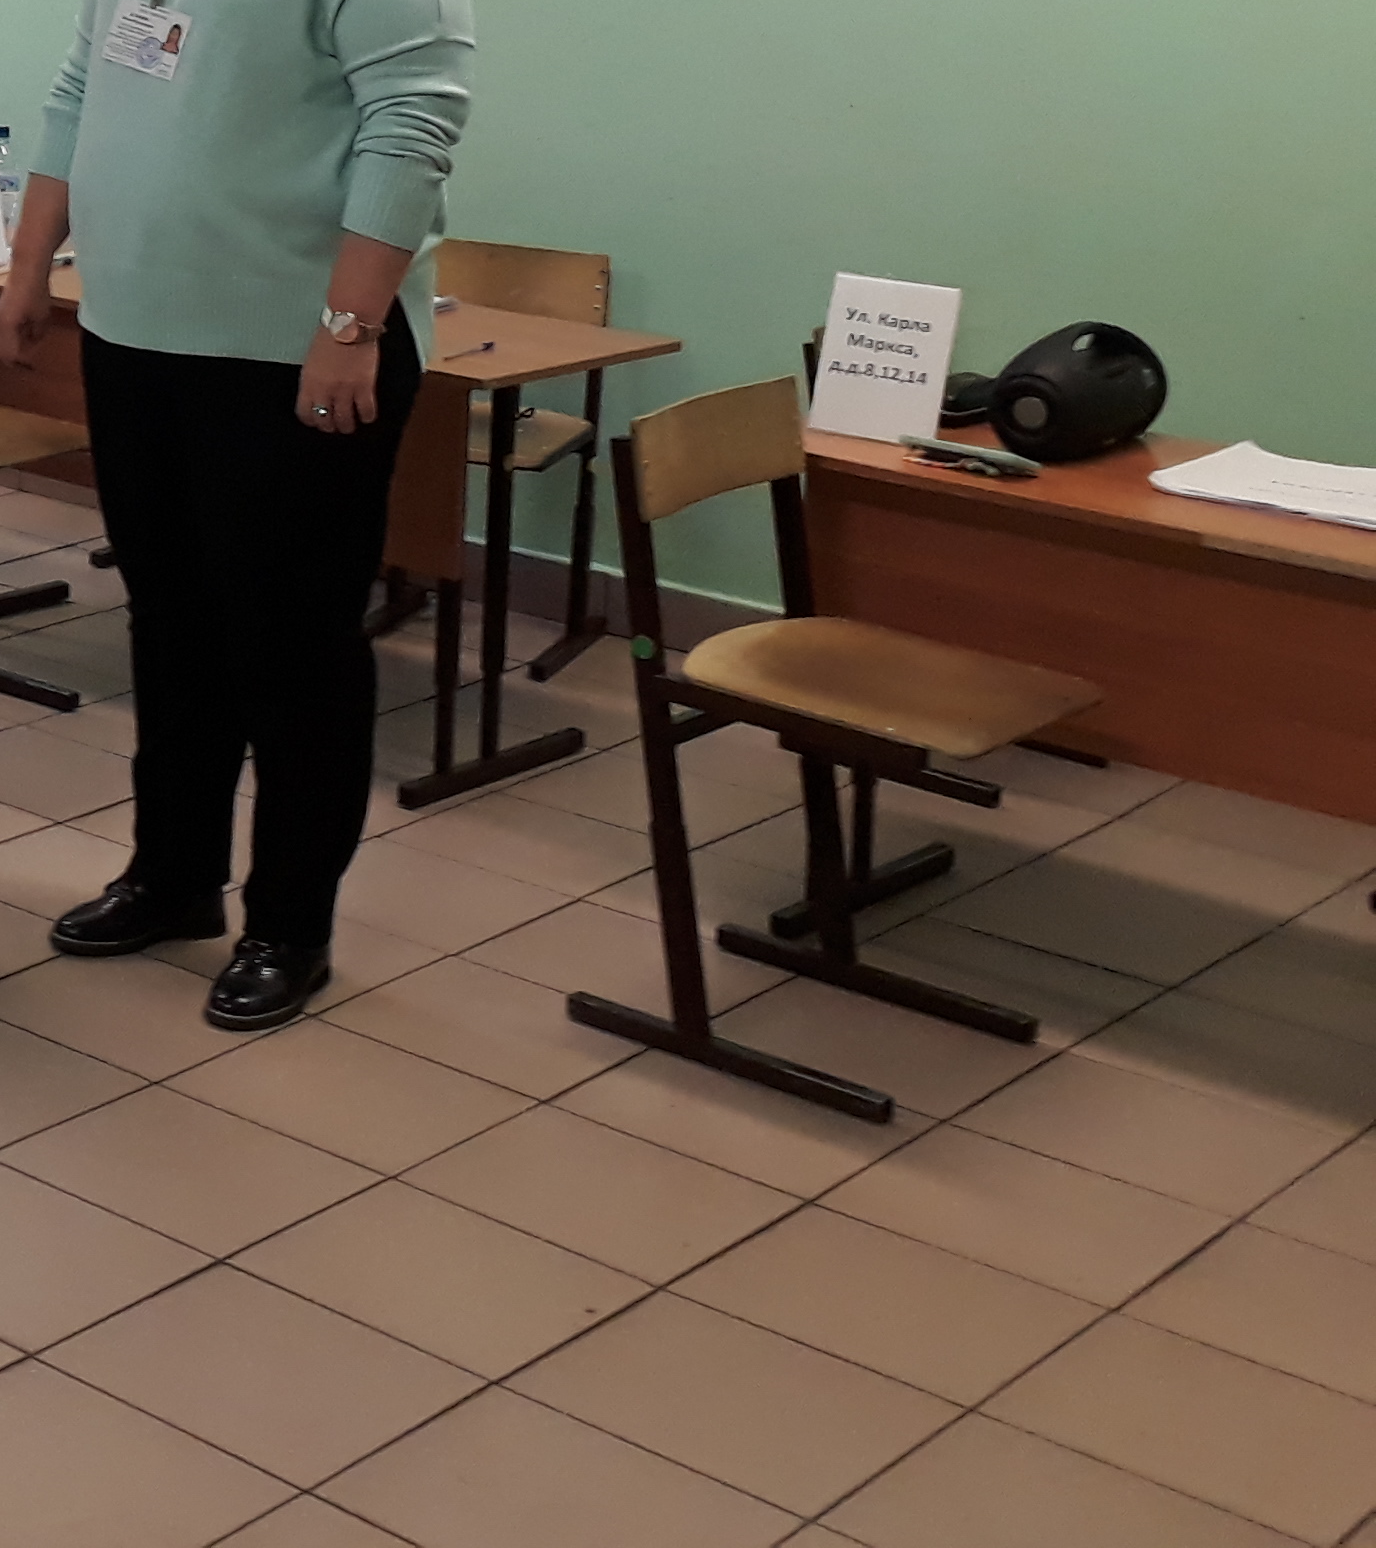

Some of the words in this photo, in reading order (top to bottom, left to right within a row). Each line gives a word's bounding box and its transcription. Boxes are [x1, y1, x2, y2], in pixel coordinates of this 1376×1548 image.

[846, 308, 871, 324] Ул.
[878, 313, 931, 333] Карла
[847, 333, 920, 358] Маркса,
